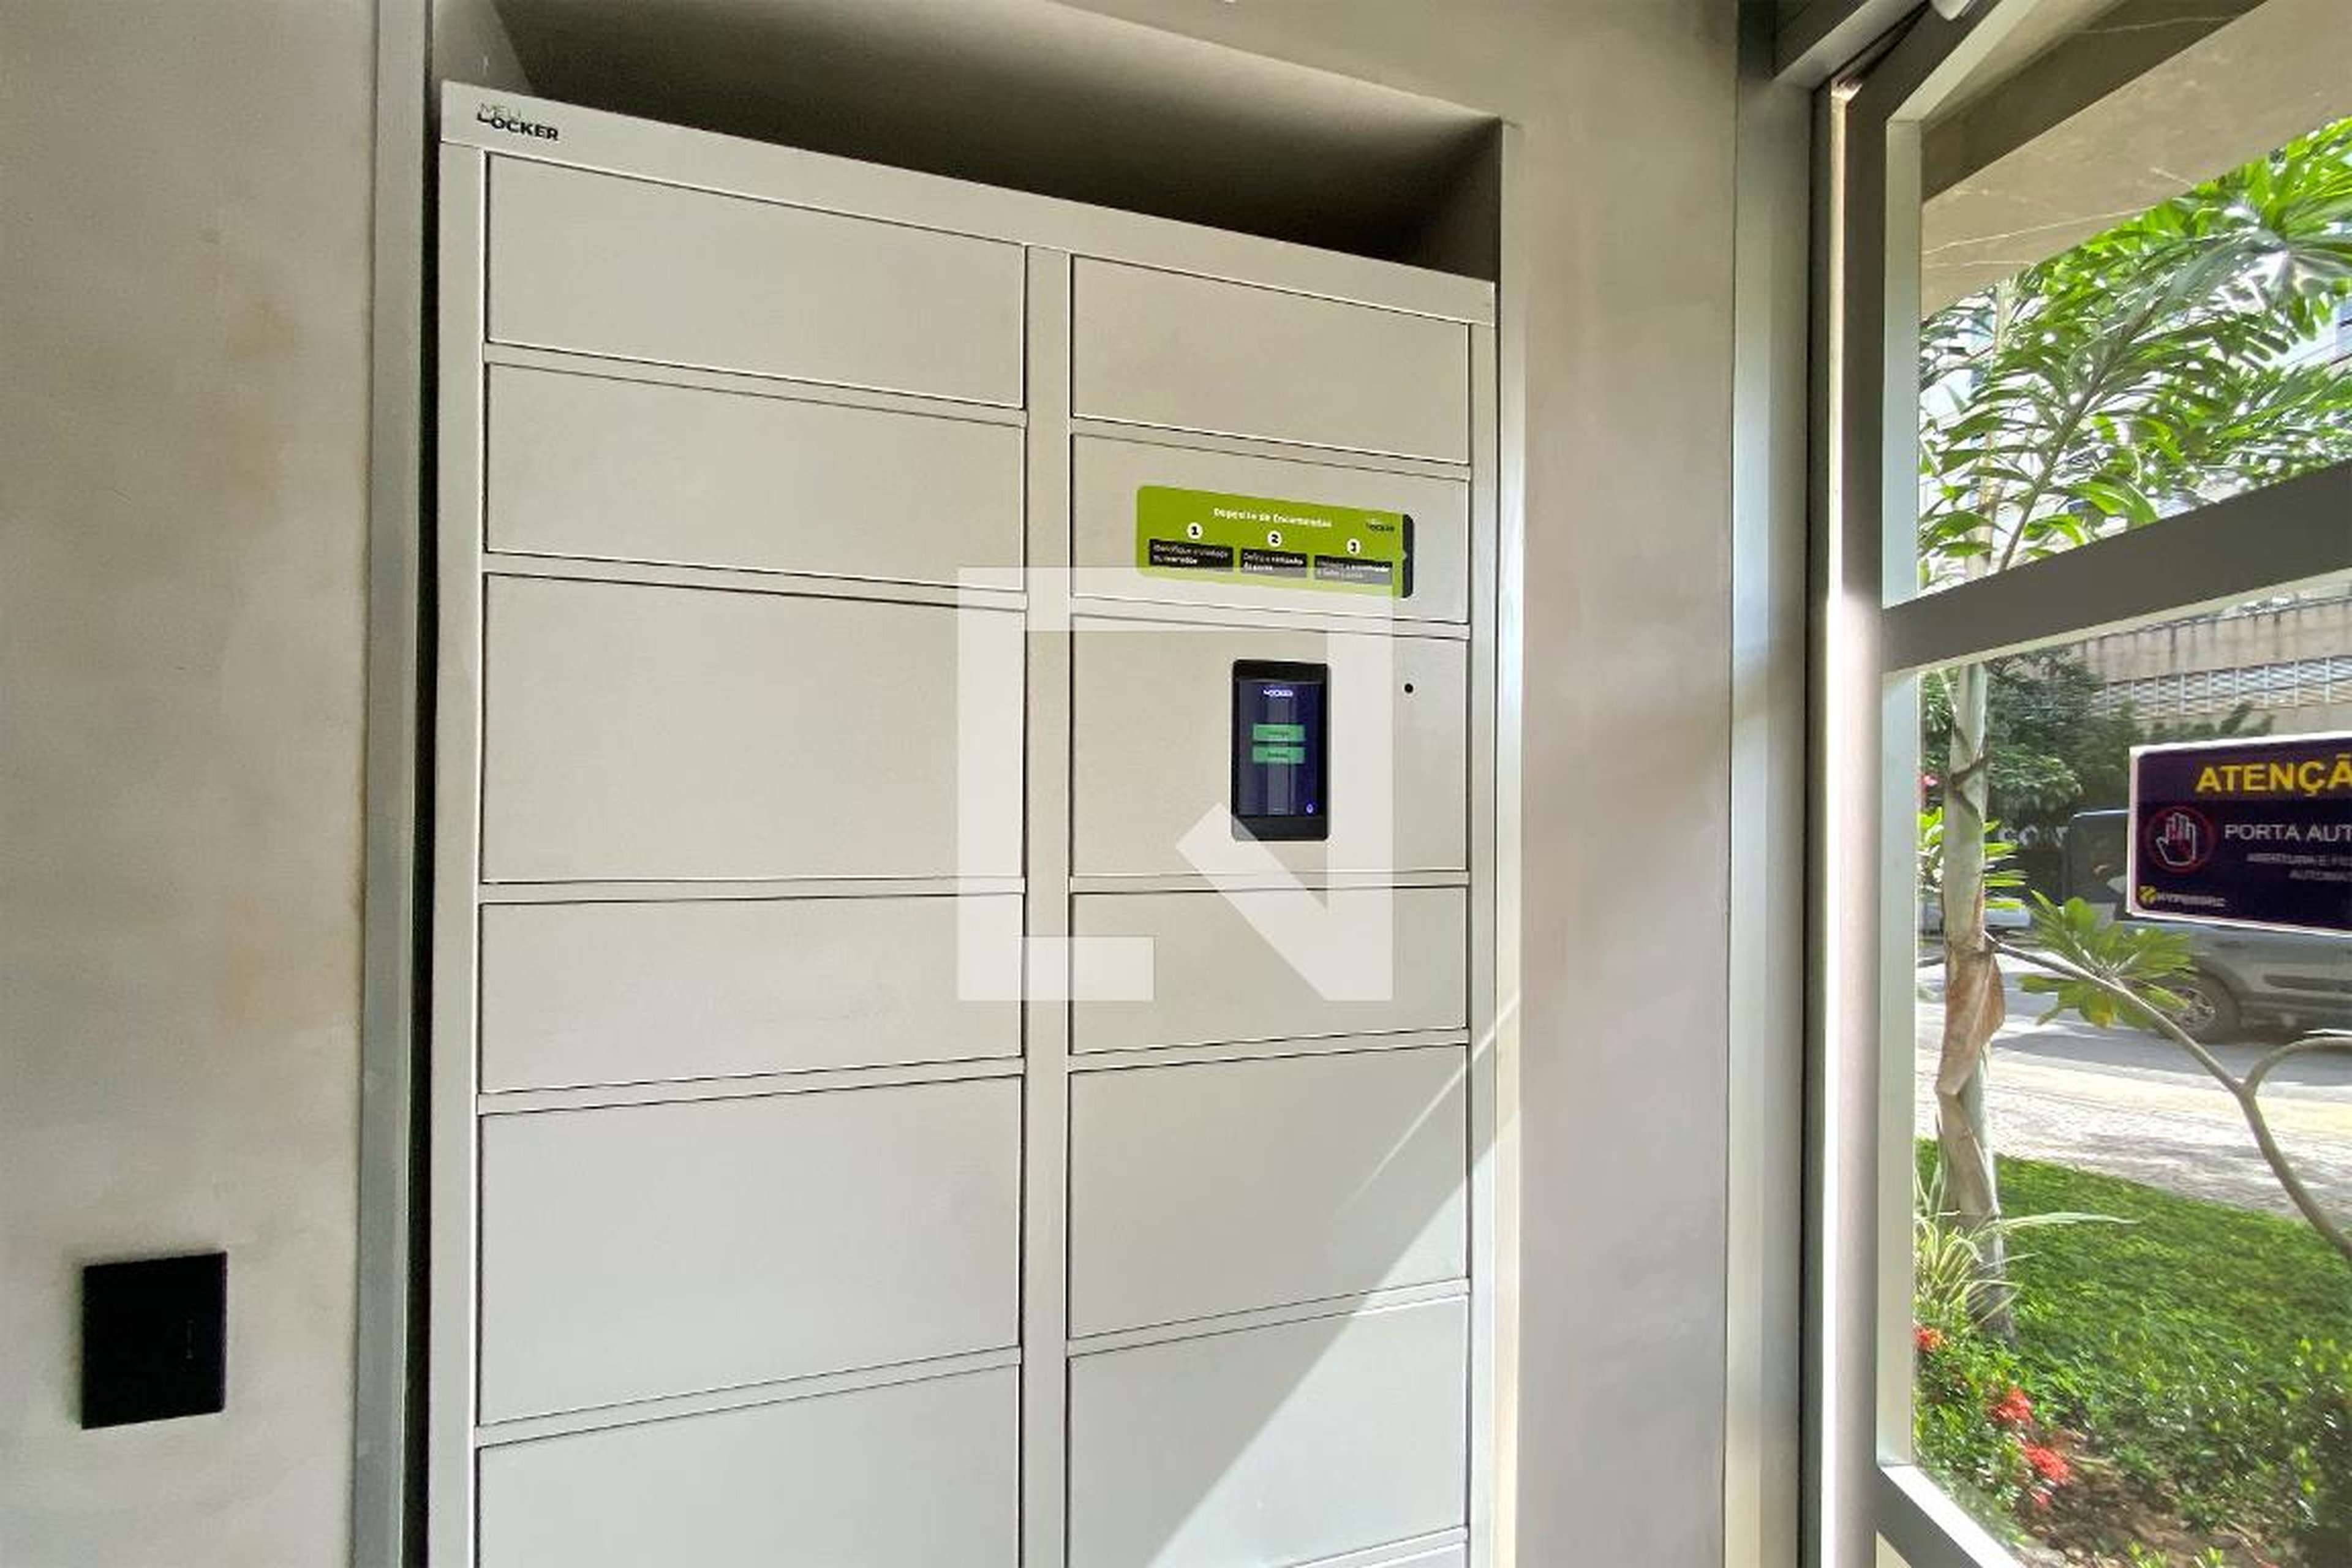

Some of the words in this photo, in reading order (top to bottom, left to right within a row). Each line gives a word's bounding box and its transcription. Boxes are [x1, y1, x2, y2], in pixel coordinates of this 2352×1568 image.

[476, 111, 559, 141] LOCKER
[1191, 526, 1199, 536] 1
[1271, 533, 1279, 544] 2
[1351, 541, 1357, 552] 3
[2195, 753, 2352, 797] ATENÇÃ
[2224, 824, 2300, 841] PORTA
